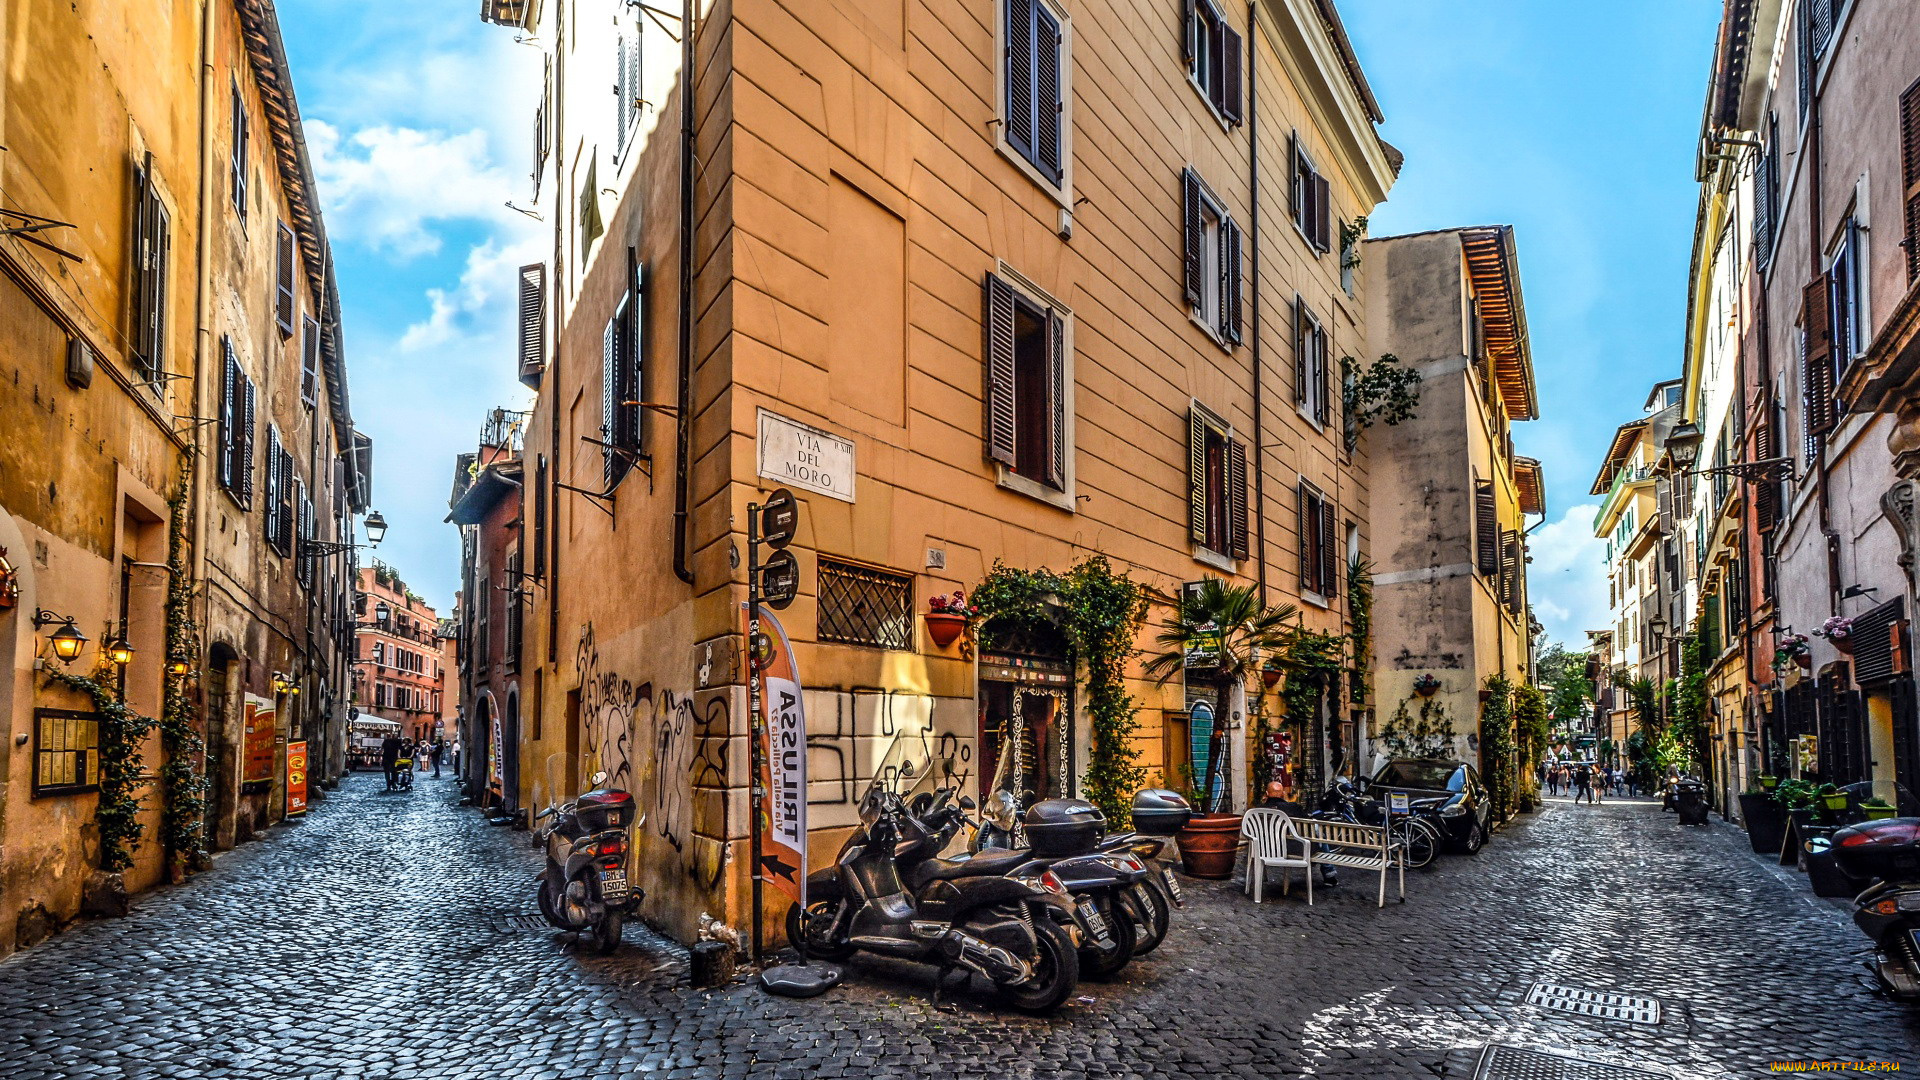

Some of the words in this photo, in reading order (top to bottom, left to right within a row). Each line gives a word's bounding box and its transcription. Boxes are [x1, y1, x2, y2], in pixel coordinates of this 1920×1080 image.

[797, 433, 821, 452] VIA
[798, 451, 820, 467] DEL
[785, 462, 831, 486] MORO
[603, 880, 626, 891] 15075
